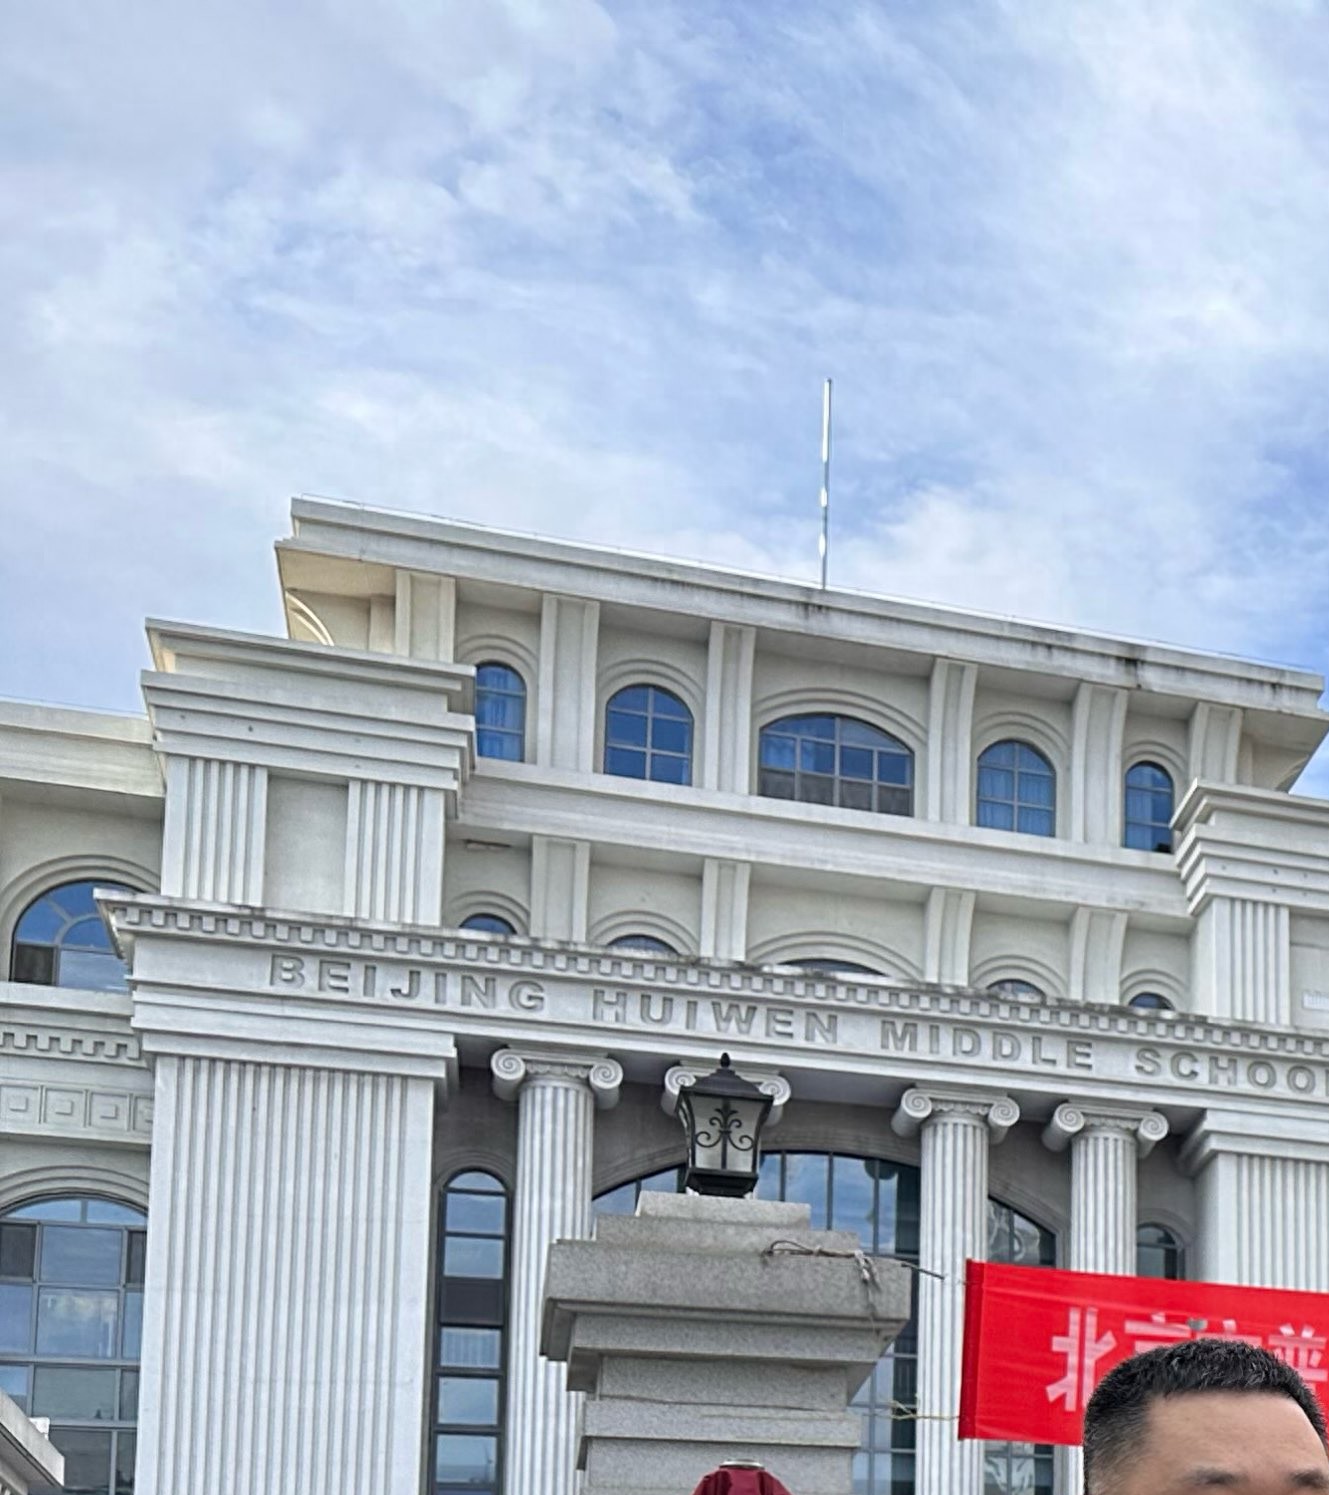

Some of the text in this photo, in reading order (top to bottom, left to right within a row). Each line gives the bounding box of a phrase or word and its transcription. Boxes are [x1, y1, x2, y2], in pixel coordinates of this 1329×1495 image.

[269, 953, 546, 1010] BEIJING
[592, 987, 839, 1044] HUIWEN
[880, 1019, 1094, 1070] MIDDLE
